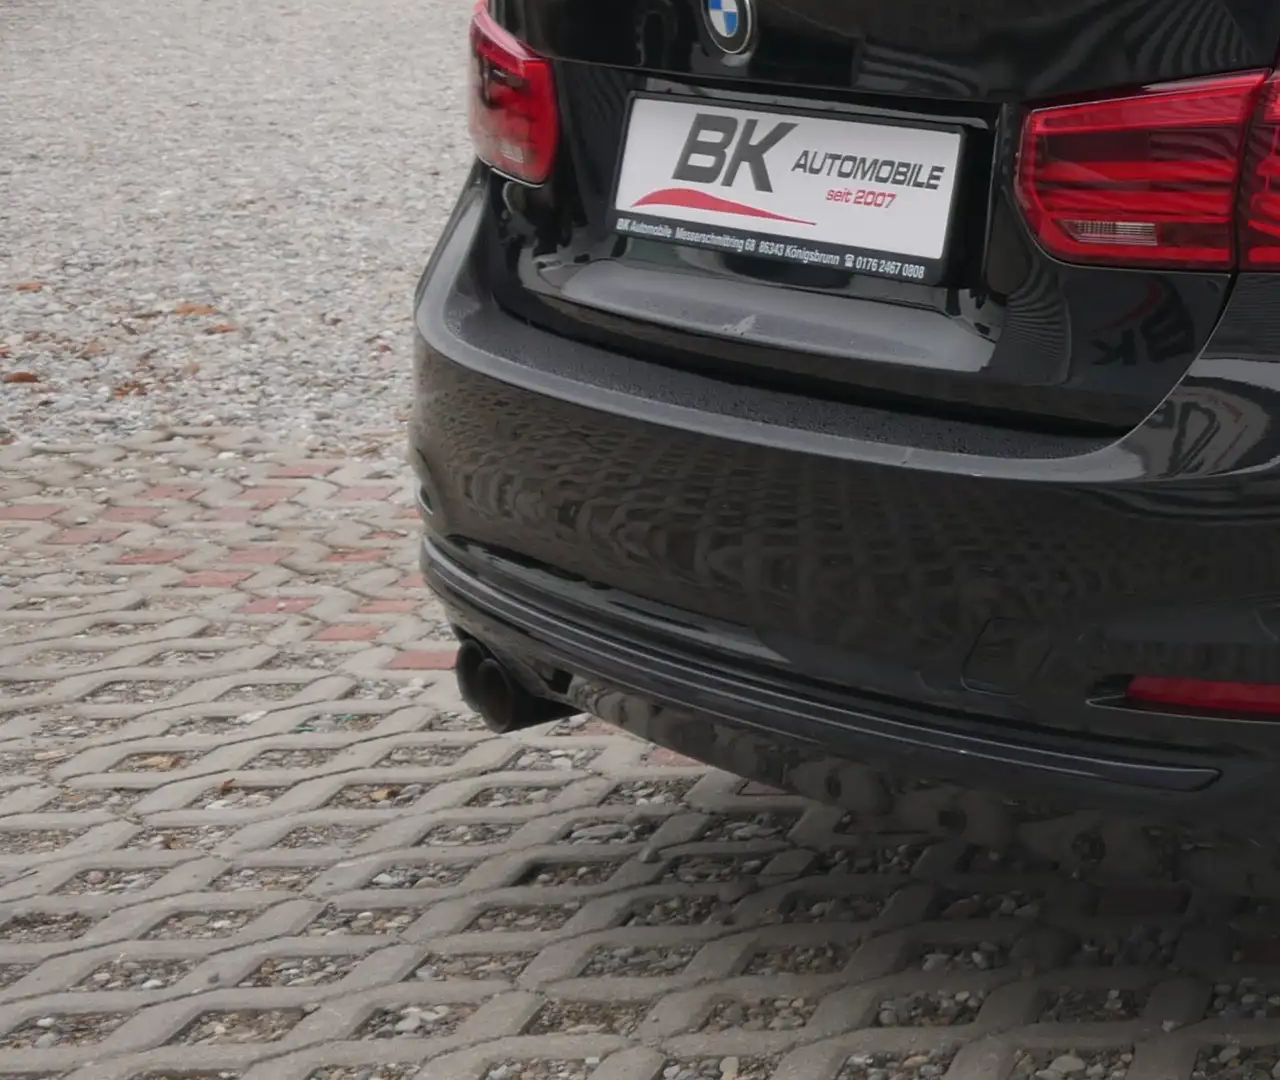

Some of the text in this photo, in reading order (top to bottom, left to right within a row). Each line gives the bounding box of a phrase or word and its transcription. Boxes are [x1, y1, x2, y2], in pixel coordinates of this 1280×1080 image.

[671, 113, 945, 193] BK AUTOMOBILE
[826, 187, 897, 209] seit 2007
[616, 218, 630, 231] BK
[630, 220, 673, 238] Automobile
[675, 227, 745, 252] Messerschmittring
[745, 238, 756, 252] 68
[758, 240, 785, 256] 86343
[785, 244, 841, 264] Königsbrunn
[855, 255, 878, 272] 0176
[878, 259, 902, 275] 2467
